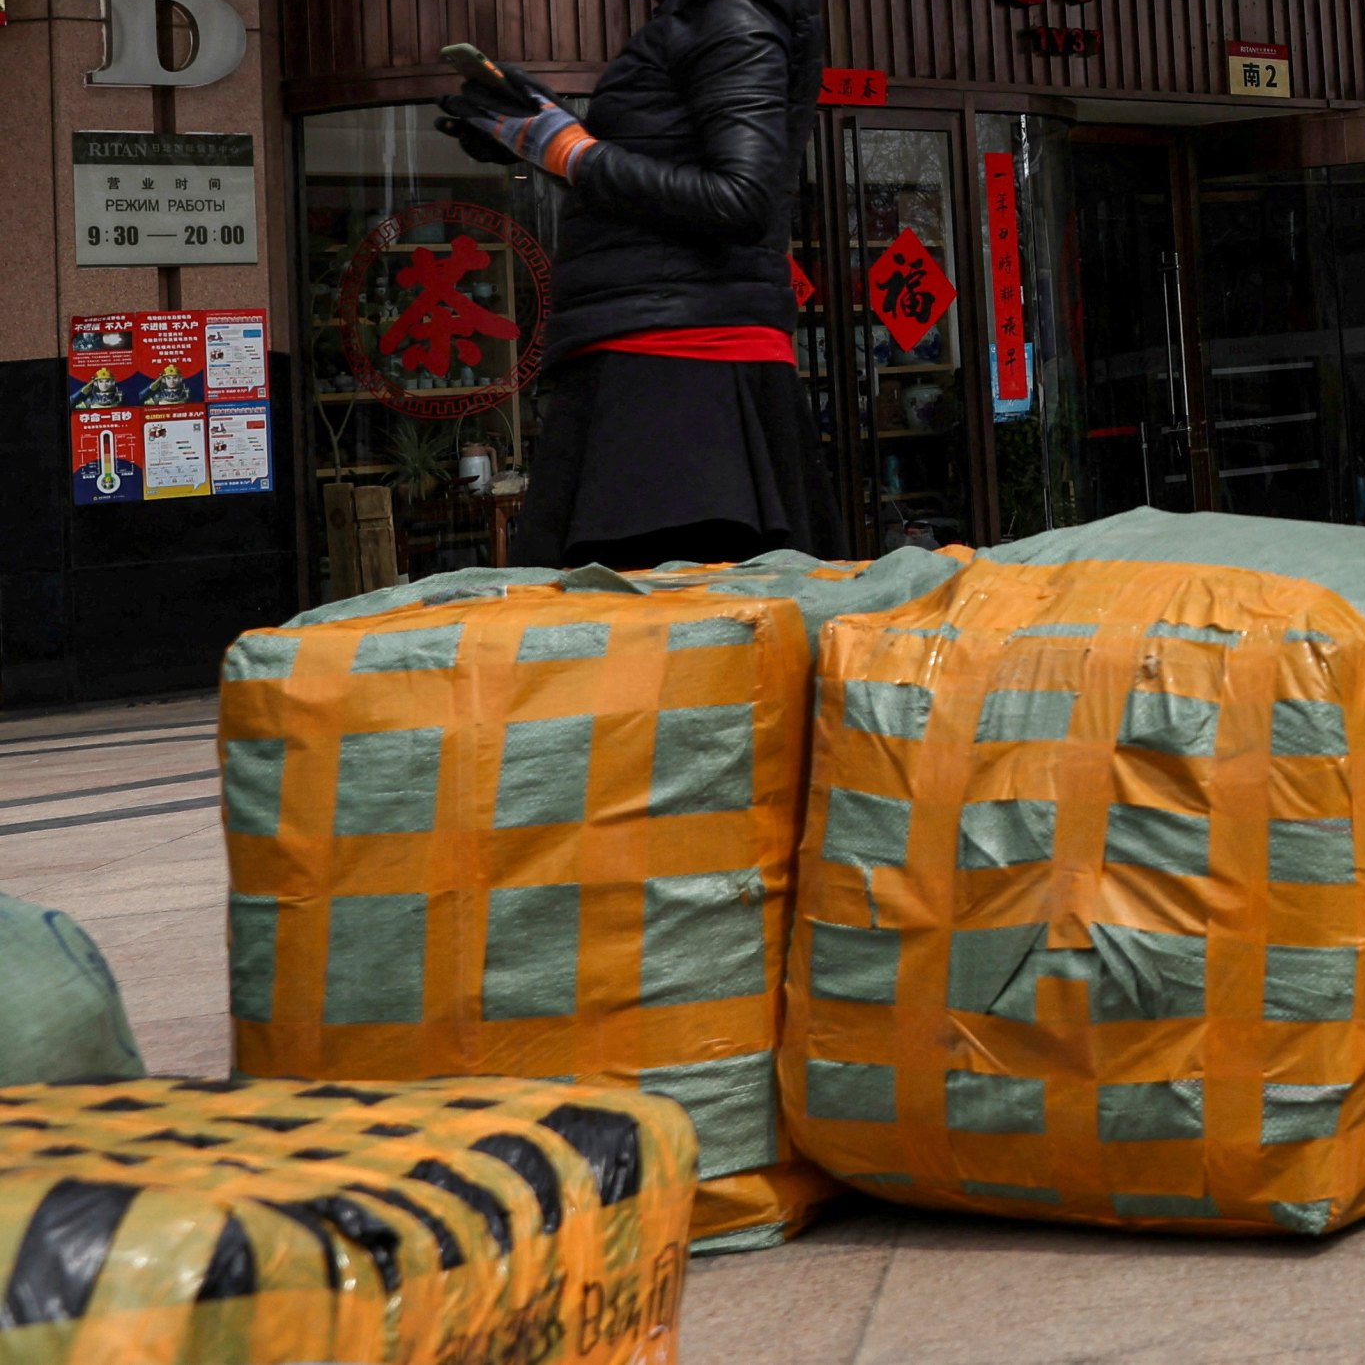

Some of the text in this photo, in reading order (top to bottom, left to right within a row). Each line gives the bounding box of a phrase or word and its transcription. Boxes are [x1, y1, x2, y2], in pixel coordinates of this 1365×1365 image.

[88, 142, 148, 157] RITAN
[107, 176, 221, 191] 营业时间
[105, 199, 225, 212] РЕЖИМ РАБОТЫ
[88, 225, 139, 246] 9:30
[184, 225, 245, 245] 20:00
[875, 253, 936, 324] 福
[379, 235, 521, 376] 茶
